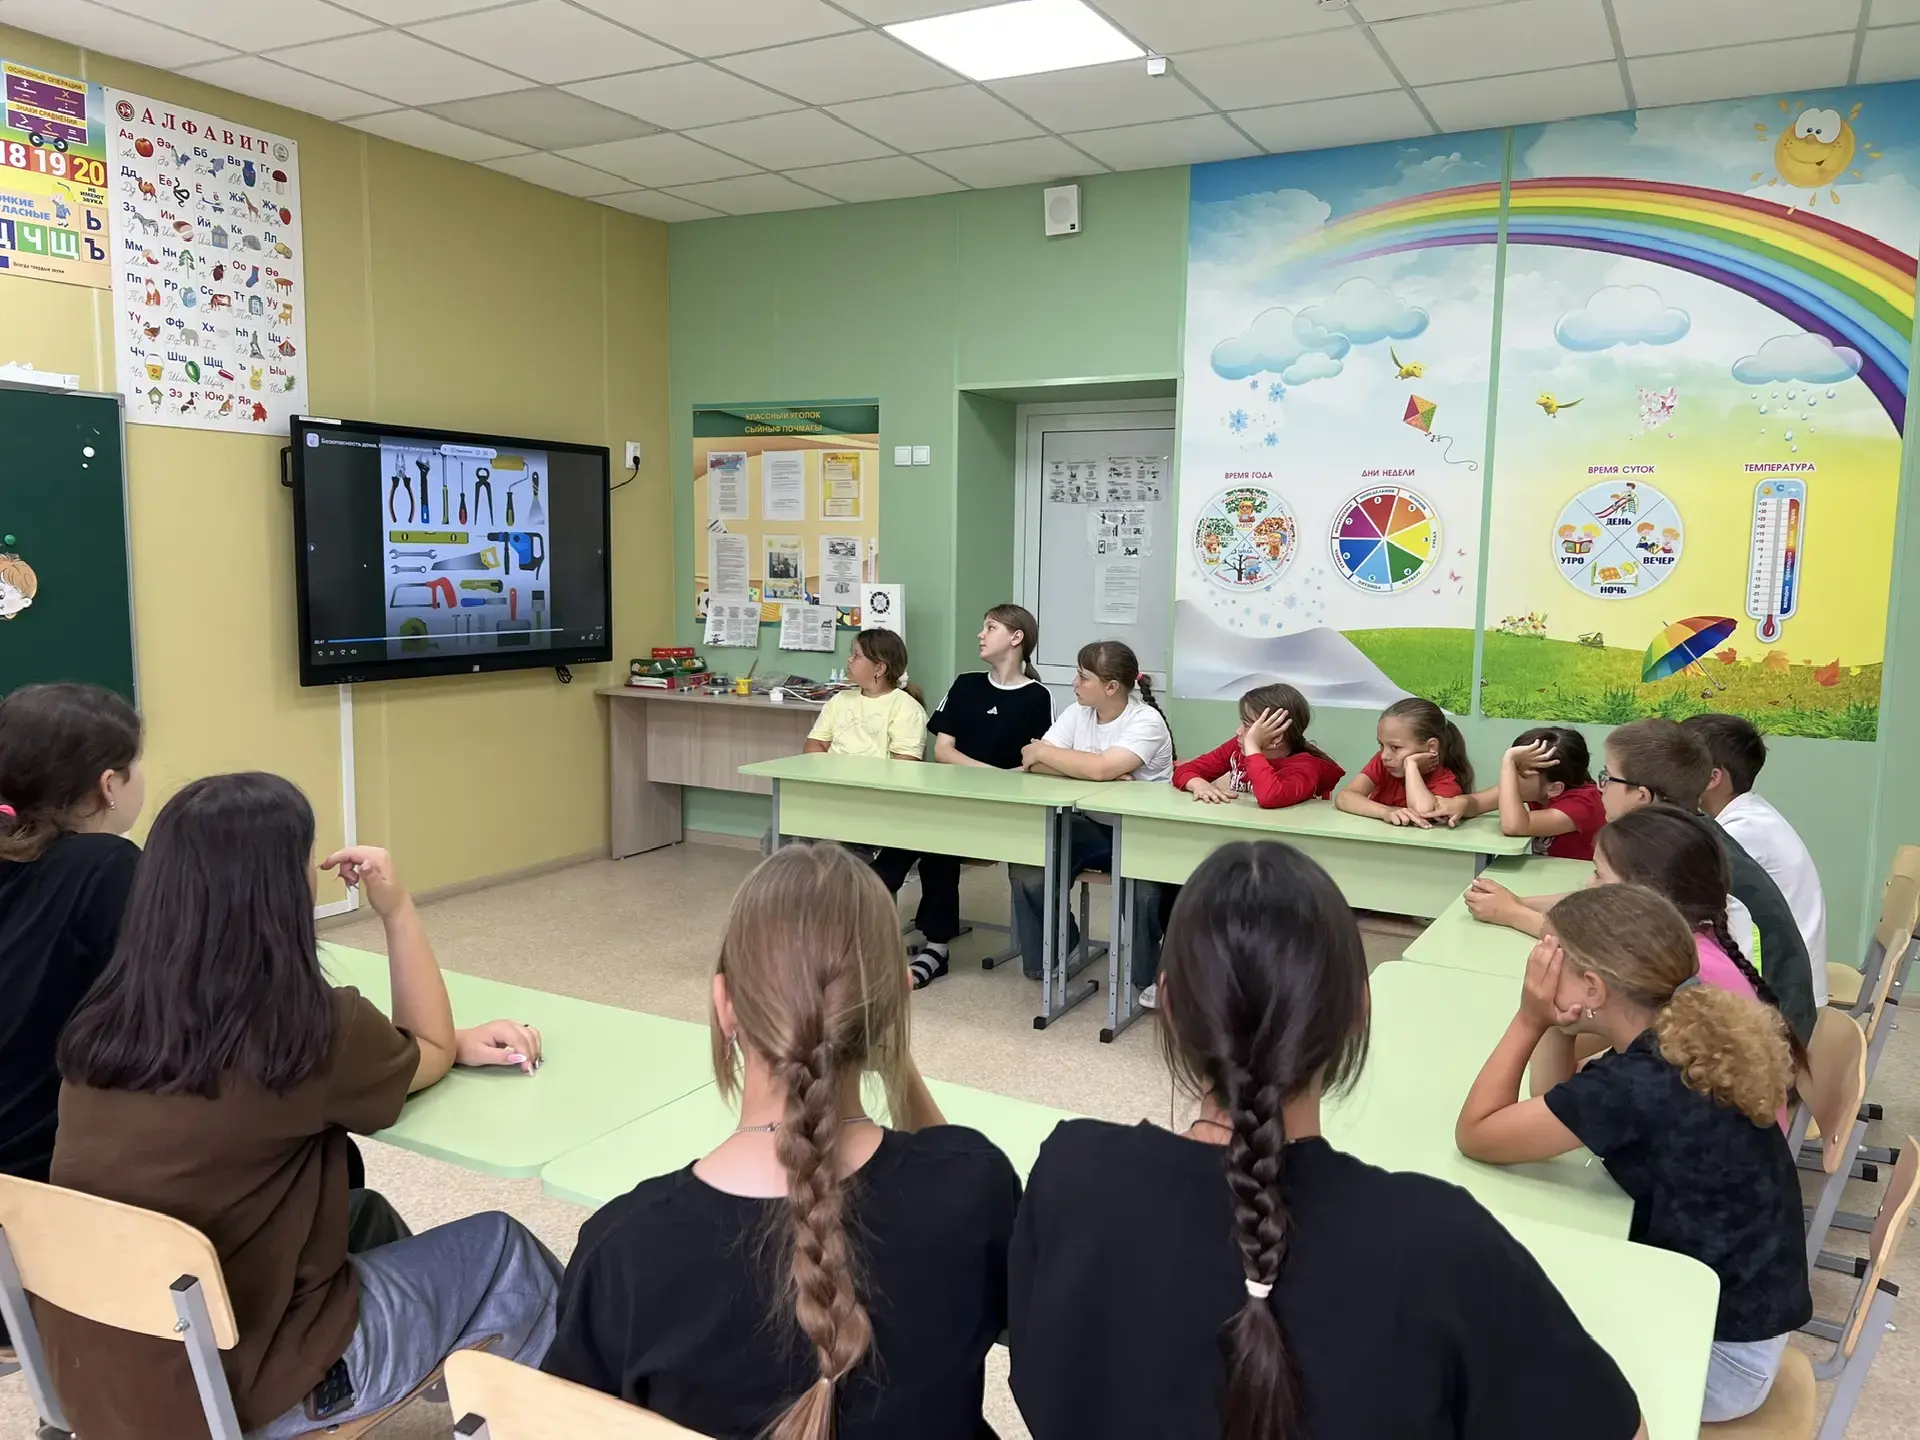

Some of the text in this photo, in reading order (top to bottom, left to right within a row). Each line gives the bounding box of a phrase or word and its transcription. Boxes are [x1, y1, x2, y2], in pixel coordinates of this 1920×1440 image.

[7, 65, 46, 81] ОСНОВНЫЕ
[47, 77, 83, 91] ОПЕРАЦИИ
[16, 104, 38, 115] ЗНАКИ
[38, 108, 78, 126] СРАВНЕНИЯ
[120, 128, 134, 140] Аа
[141, 107, 269, 154] АЛФАВИТ
[193, 146, 208, 158] Бб
[227, 155, 242, 167] Вв
[34, 148, 67, 177] 19
[73, 156, 106, 187] 20
[120, 165, 137, 178] Дд
[260, 163, 271, 174] Гг
[80, 191, 104, 200] ИМЕЮТ
[82, 196, 103, 205] ЗВУКА
[229, 191, 246, 204] Жж
[0, 204, 50, 220] ЛАСНЫЕ
[123, 202, 136, 213] Зз
[86, 210, 102, 230] Ь
[160, 209, 175, 221] Ии
[197, 215, 212, 228] Йй
[231, 224, 243, 235] Кк
[24, 226, 43, 252] Ч
[51, 231, 80, 261] Щ
[264, 231, 278, 244] Лл
[85, 237, 105, 260] Ъ
[125, 238, 144, 252] Мм
[162, 246, 178, 258] Нн
[232, 260, 247, 271] Оо
[127, 272, 142, 284] Пп
[164, 279, 178, 292] Рр
[200, 285, 214, 296] Сс
[233, 290, 246, 301] Тт
[266, 296, 278, 310] Уу
[165, 317, 185, 330] Фф
[202, 321, 215, 333] Хх
[268, 332, 282, 344] Цц
[130, 346, 146, 357] Чч
[167, 350, 187, 363] Шш
[203, 356, 224, 369] Щщ
[270, 365, 287, 376] Ыы
[168, 388, 183, 399] Ээ
[204, 391, 225, 402] Юю
[238, 396, 252, 406] Яя
[746, 410, 821, 420] КЛАССНЫЙ УГОЛОК
[744, 424, 823, 434] СЫЙНЫФ ПОЧМАГЫ
[1362, 468, 1415, 478] ДНИ НЕДЕЛИ
[1588, 466, 1655, 474] ВРЕМЯ СУТОК
[1744, 462, 1816, 472] ТЕМПЕРАТУРА
[1224, 472, 1273, 480] ВРЕМЯ ГОДА
[1606, 518, 1632, 526] ДЕНЬ
[1560, 556, 1584, 565] УТРО
[1642, 556, 1674, 565] ВЕЧЕР
[1600, 586, 1626, 594] НОЧЬ
